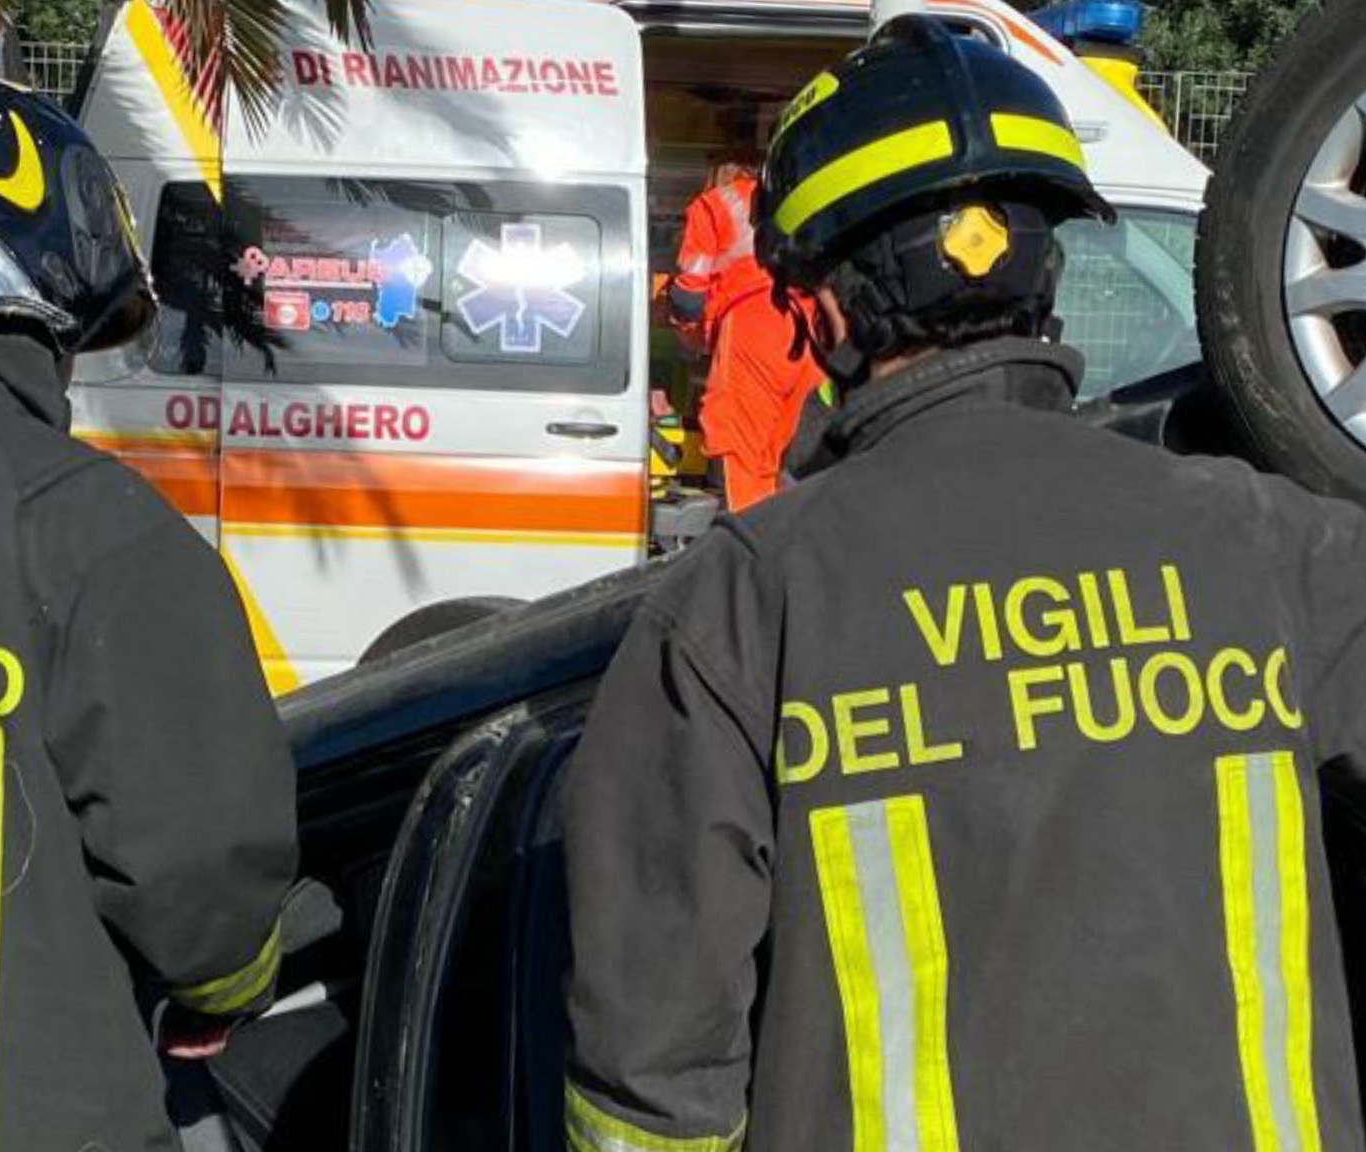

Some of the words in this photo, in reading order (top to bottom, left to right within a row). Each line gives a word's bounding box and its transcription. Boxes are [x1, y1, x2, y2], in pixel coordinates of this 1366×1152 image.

[341, 52, 619, 97] RIANIMAZIONE
[902, 564, 1192, 667] VIGILI
[775, 681, 964, 786] DEL
